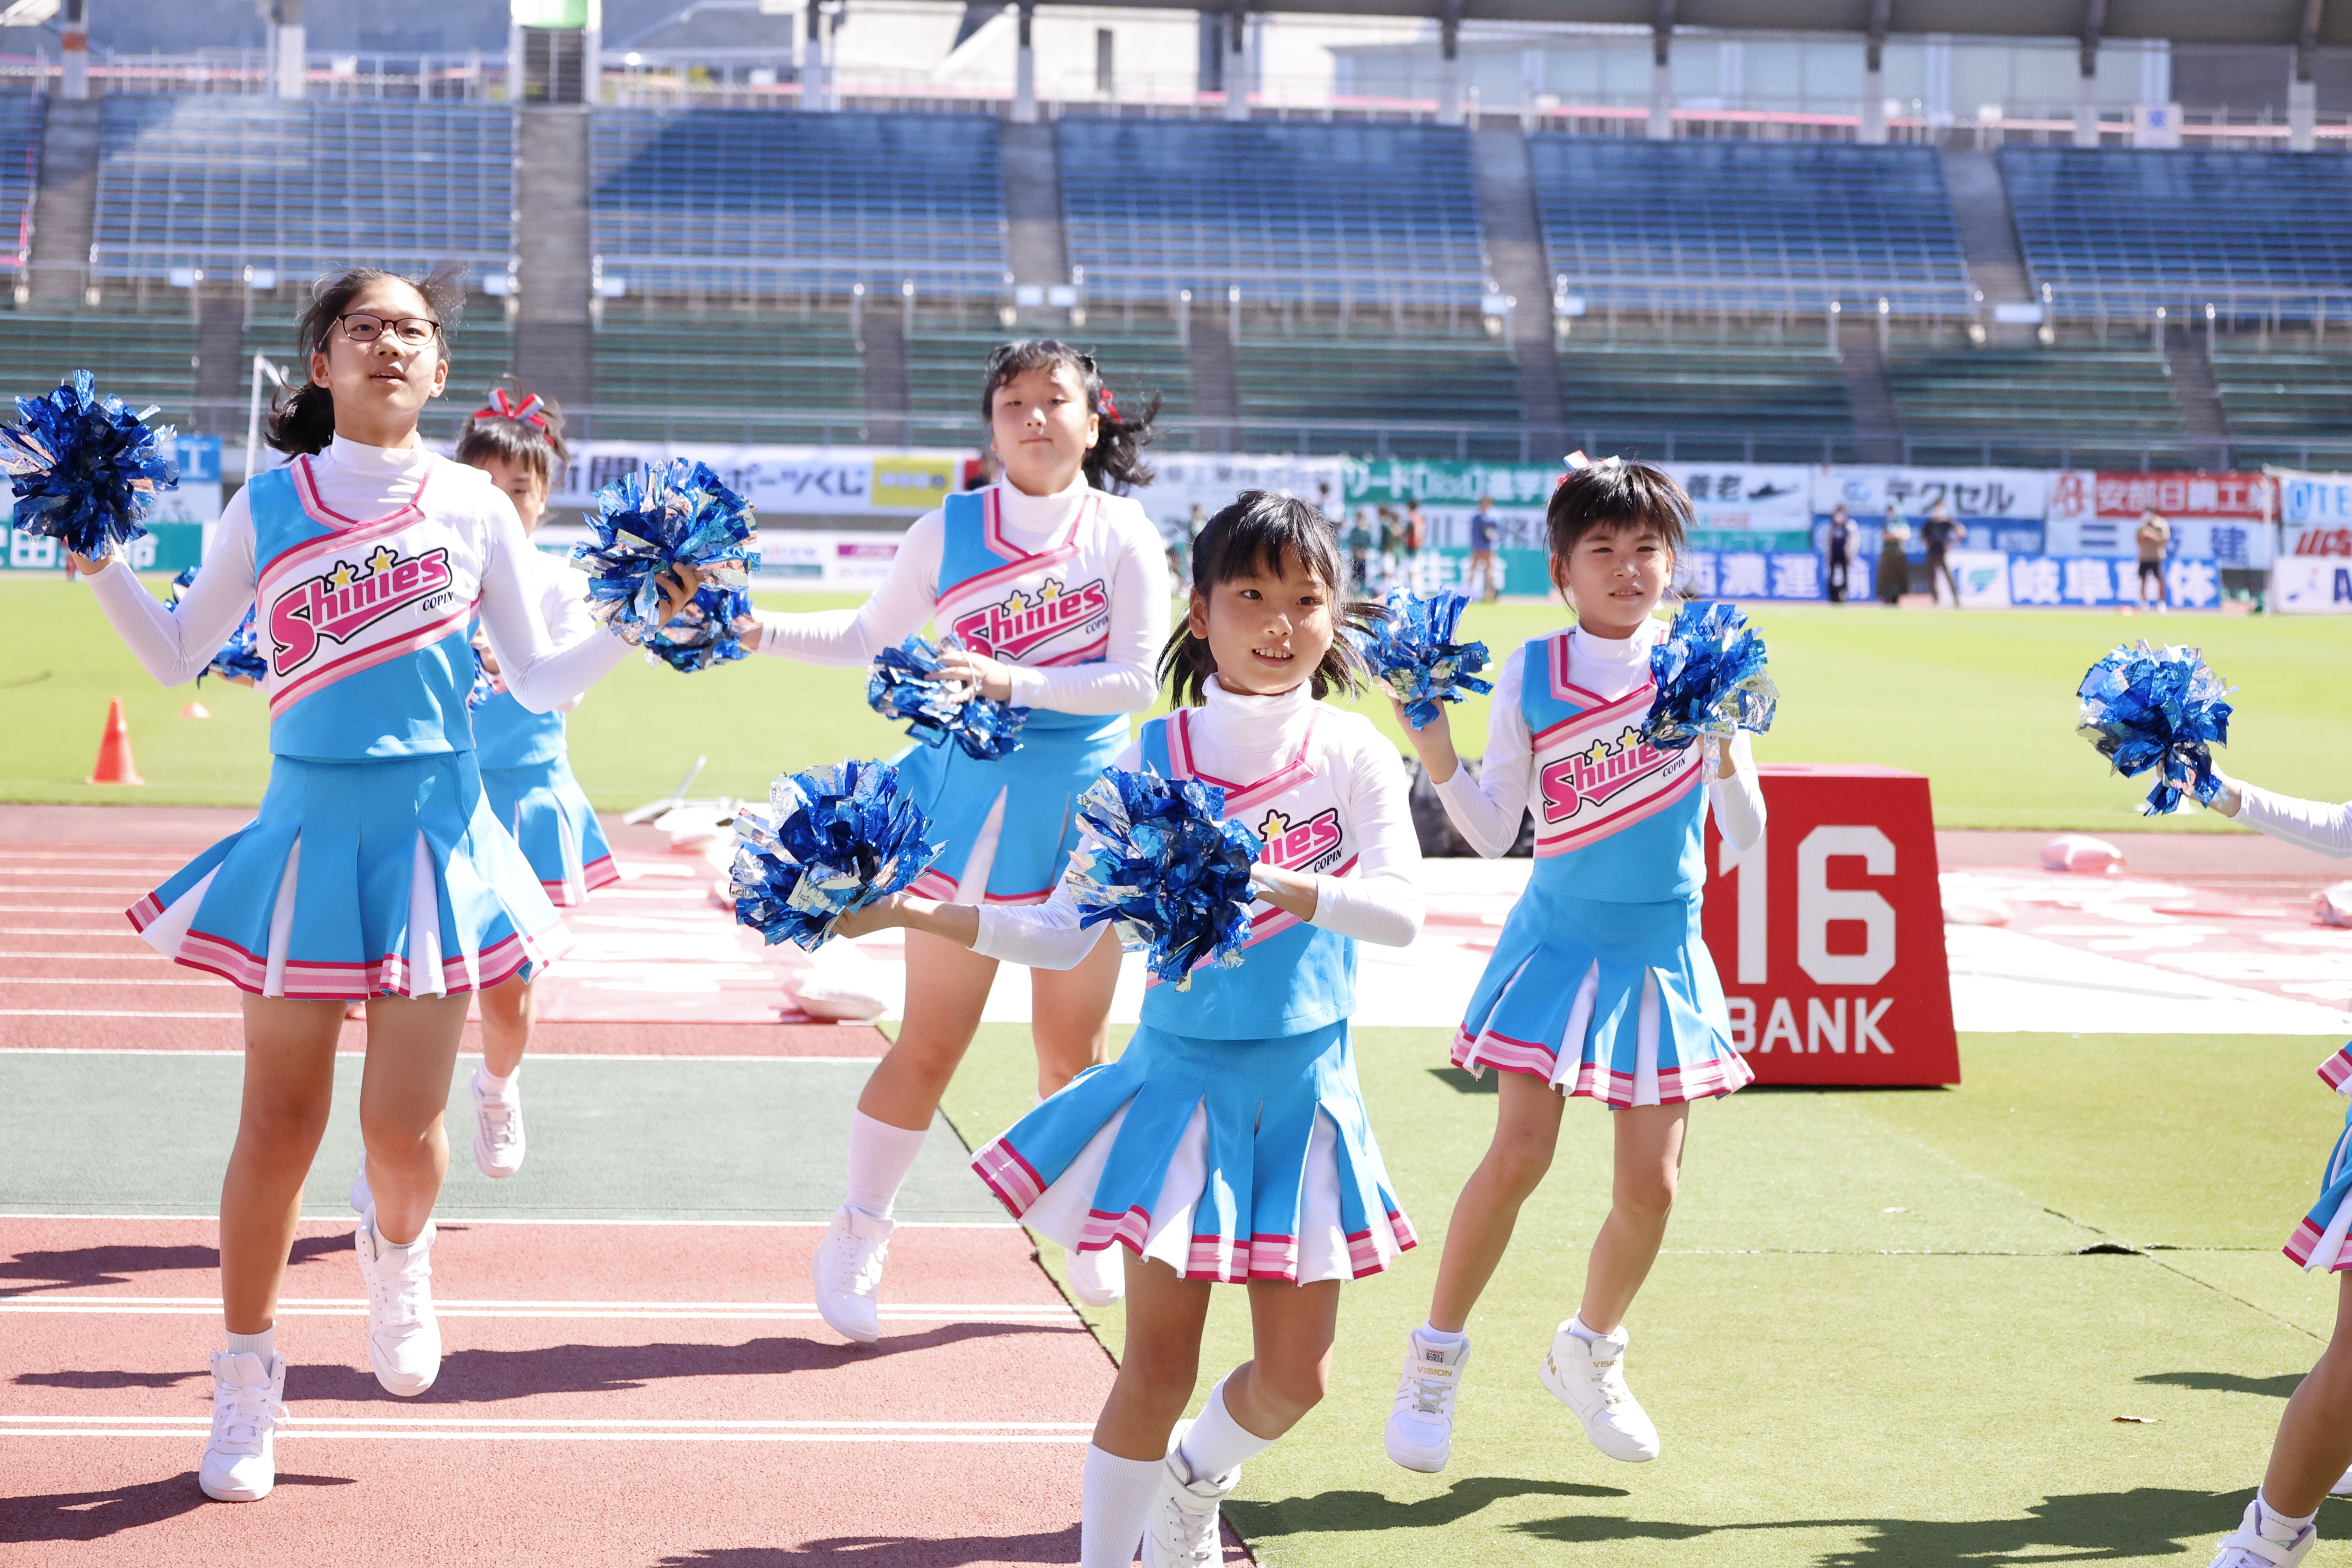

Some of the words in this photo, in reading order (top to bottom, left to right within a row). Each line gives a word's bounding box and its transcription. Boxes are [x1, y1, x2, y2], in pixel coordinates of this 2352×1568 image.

[721, 463, 864, 495] ポーツくじ
[270, 549, 451, 676] Shinies
[423, 591, 454, 611] COPIN
[953, 580, 1108, 659] Shinies
[1541, 743, 1683, 822] Shinie
[1663, 756, 1686, 778] COPIN
[1314, 847, 1343, 873] COPIN
[1719, 825, 1896, 985] 16
[1724, 997, 1895, 1054] BANK
[1417, 1366, 1453, 1377] VISION
